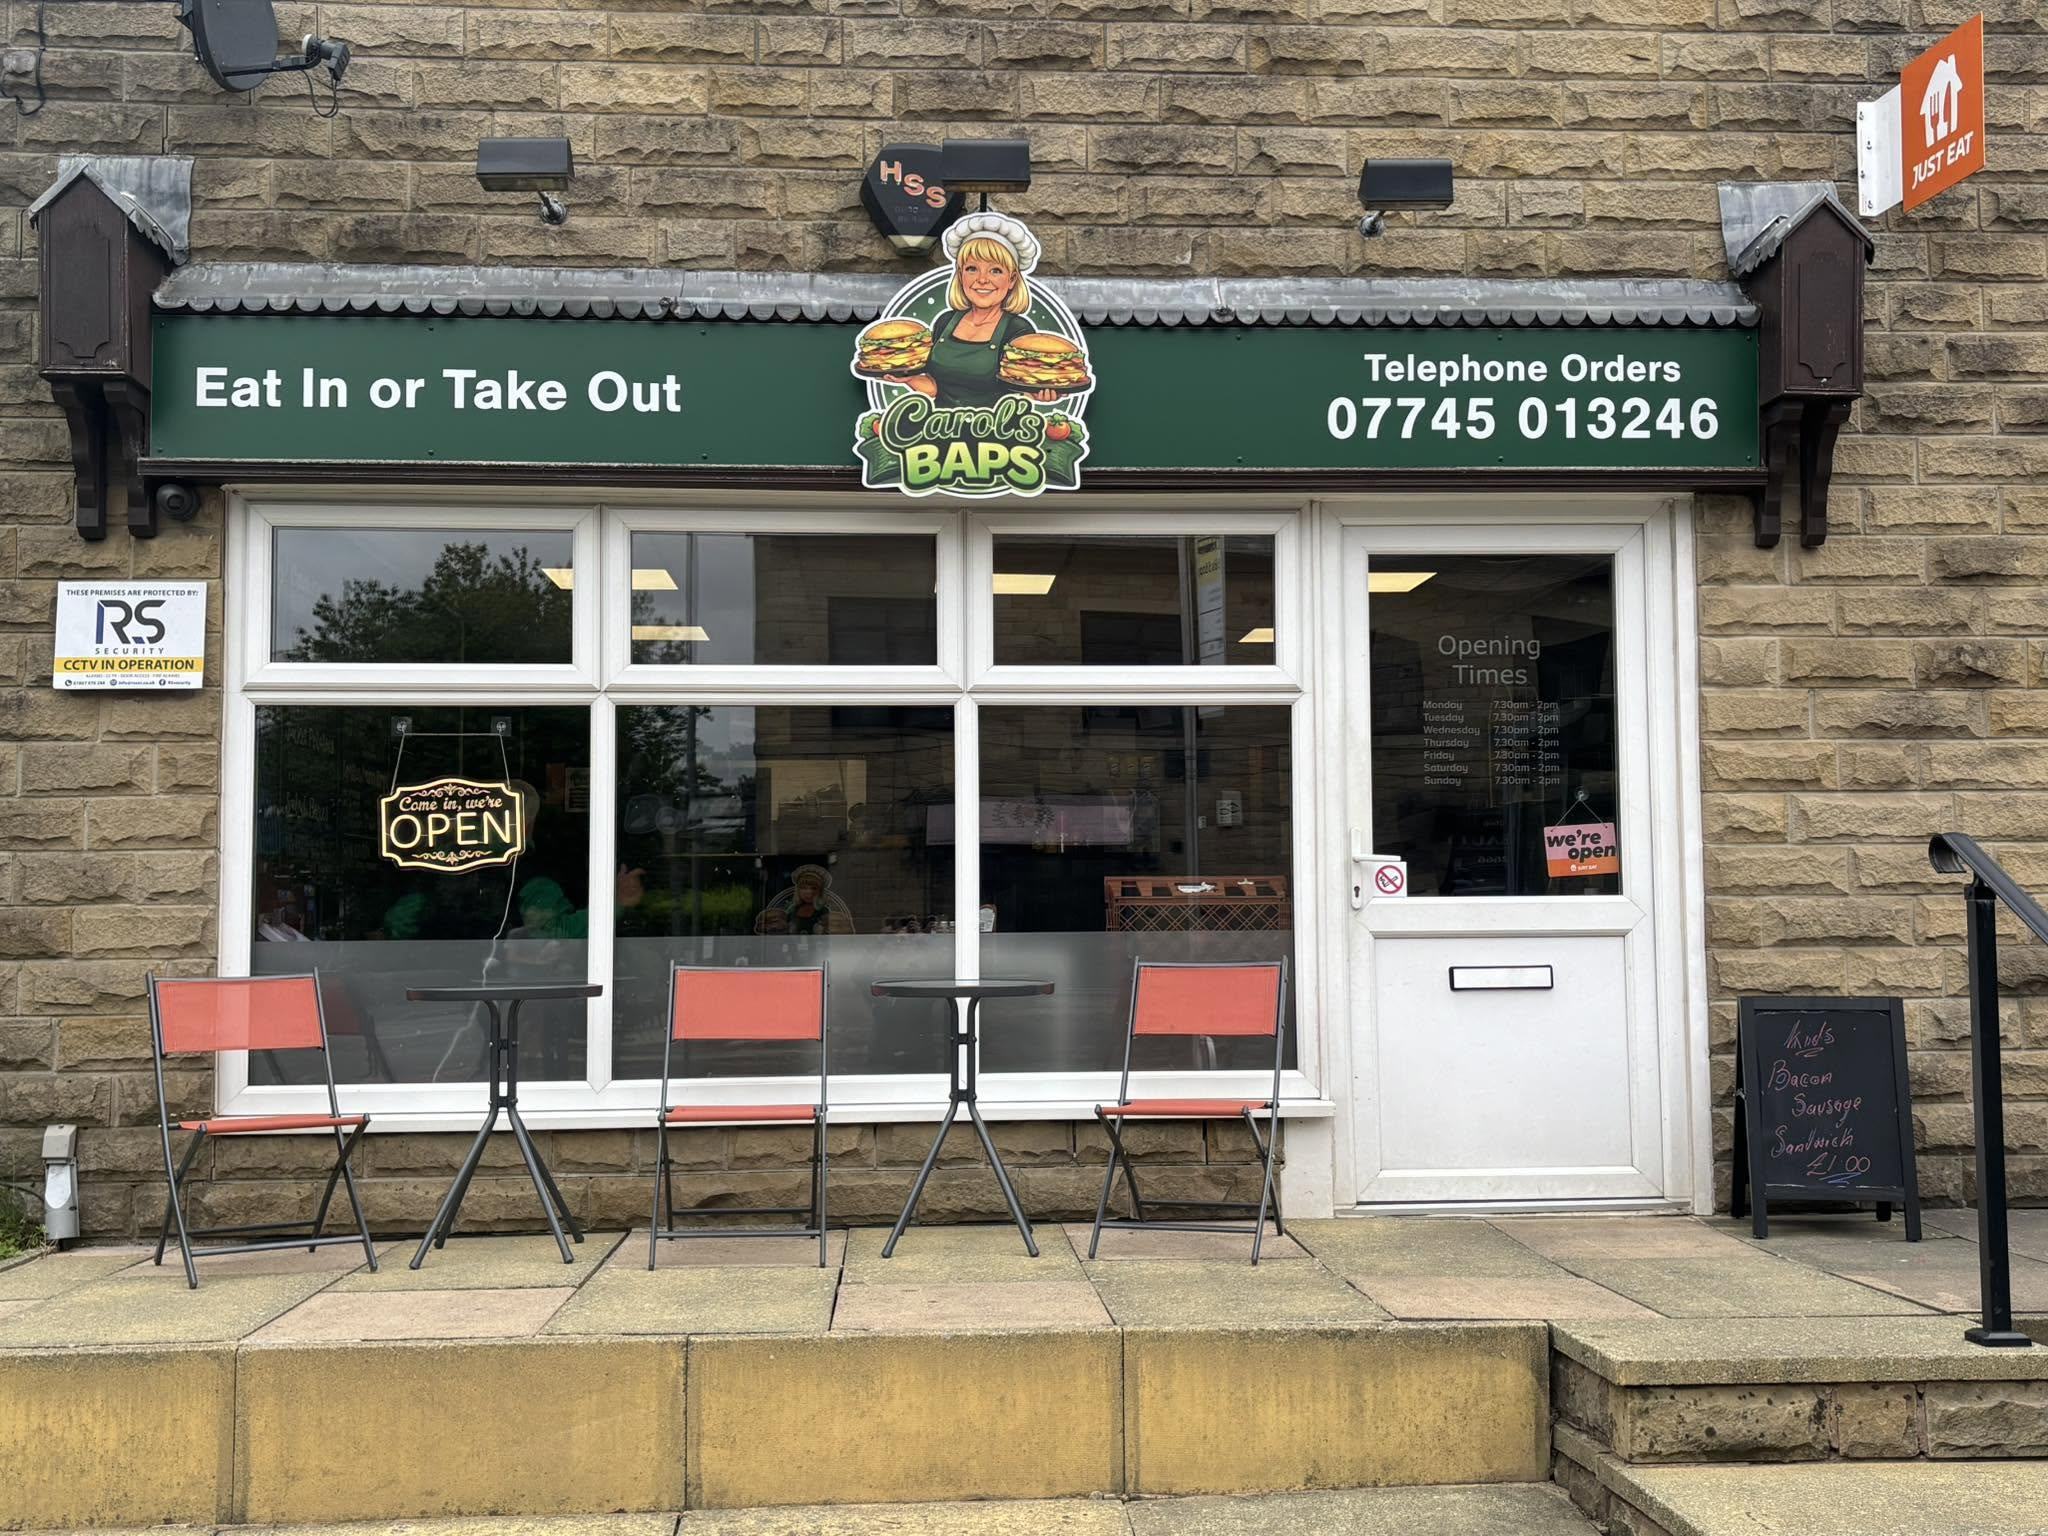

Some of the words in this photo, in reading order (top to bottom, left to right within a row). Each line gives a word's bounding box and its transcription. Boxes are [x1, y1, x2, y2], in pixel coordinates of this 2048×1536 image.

[1911, 149, 1945, 190] JUST
[1946, 130, 1974, 166] EAT
[880, 160, 947, 208] HSS
[1364, 353, 1548, 388] Telephone
[1560, 353, 1681, 383] Orders
[196, 366, 282, 408] Eat
[302, 367, 348, 408] In
[369, 377, 425, 409] or
[442, 368, 568, 411] Take
[587, 370, 682, 413] Out
[884, 396, 1042, 449] Carol's
[1327, 396, 1496, 440] 07745
[1518, 396, 1719, 440] 013246
[905, 441, 1041, 485] BAPS
[128, 589, 142, 597] ARE
[143, 589, 186, 597] PROTECTED
[95, 599, 167, 645] RS
[95, 647, 165, 655] SECURITY
[1438, 635, 1541, 661] Opening
[63, 659, 99, 671] CCTV
[101, 660, 115, 670] IN
[118, 660, 194, 670] OPERATION
[1452, 664, 1528, 685] Times
[1423, 701, 1463, 711] Monday
[1537, 701, 1559, 711] 2pm
[1423, 713, 1464, 723] Tuesday
[1537, 713, 1559, 723] 2pm
[1423, 725, 1481, 735] Wednesday
[1537, 726, 1559, 735] 2pm
[1424, 738, 1469, 748] Thursday
[1538, 738, 1559, 748] 2pm
[1424, 751, 1455, 761] Friday
[1538, 751, 1559, 761] 2pm
[1424, 763, 1469, 774] Saturday
[1538, 764, 1560, 774] 2pm
[1424, 776, 1462, 786] Sunday
[1538, 776, 1560, 786] 2pm
[399, 796, 438, 812] Come
[443, 797, 462, 812] in,
[465, 796, 503, 810] we're
[390, 810, 511, 849] OPEN
[1546, 829, 1602, 848] we're
[1568, 845, 1616, 863] open
[1768, 1060, 1833, 1091] Bacon
[1792, 1093, 1862, 1128] Sausage
[1771, 1125, 1854, 1158] Sandwich
